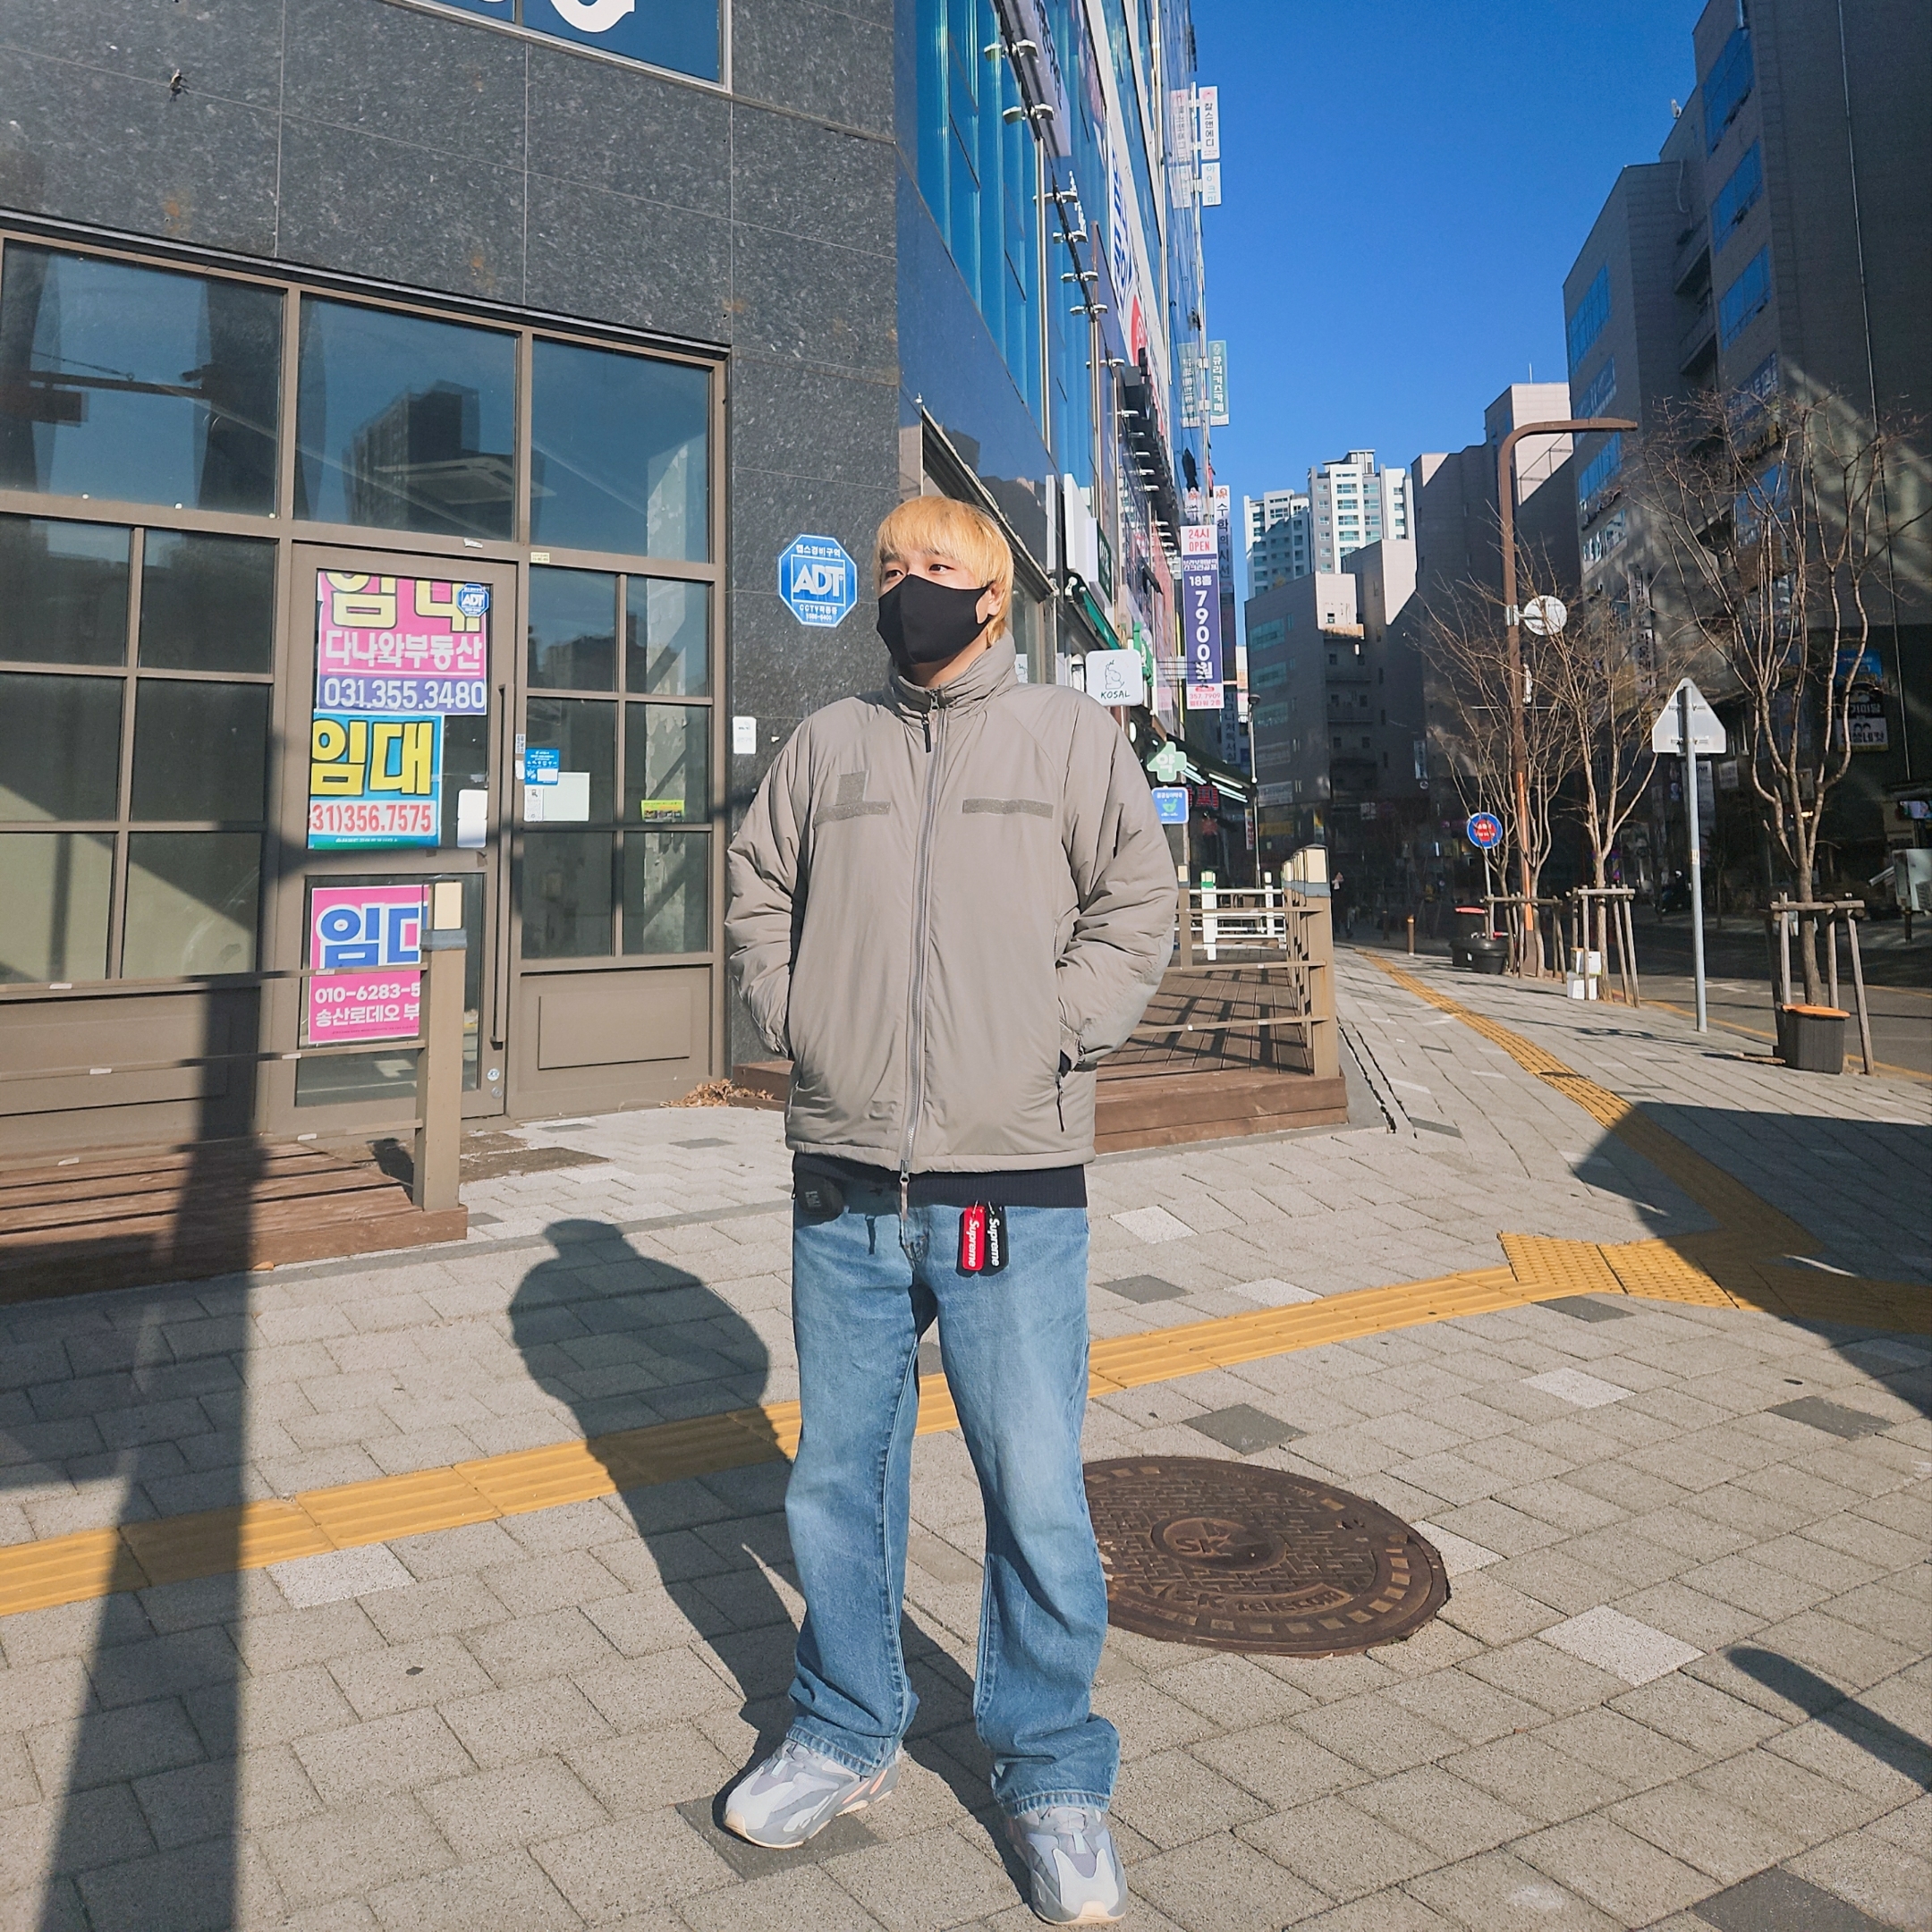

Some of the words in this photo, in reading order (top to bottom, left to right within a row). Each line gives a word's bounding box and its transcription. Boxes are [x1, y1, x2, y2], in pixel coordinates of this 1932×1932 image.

[1189, 529, 1209, 538] 24시
[1216, 503, 1231, 579] 수학의시선
[796, 544, 841, 558] 캡스경비구역
[1189, 541, 1210, 552] OPEN
[792, 564, 843, 597] ADT
[1189, 575, 1212, 587] 18홀
[462, 593, 484, 606] ADT
[326, 630, 483, 670] 다나와부동산
[324, 678, 486, 709] 031.355.3480
[1100, 691, 1131, 699] KOSAL
[310, 717, 435, 797] 임대
[1156, 753, 1175, 774] 약
[309, 804, 432, 833] 31)356.7575
[316, 1004, 400, 1028] 송산로데오
[966, 1217, 980, 1267] Supreme
[987, 1217, 1001, 1267] Supreme
[1175, 1534, 1232, 1555] SK
[1173, 1587, 1227, 1611] SK
[1236, 1590, 1344, 1614] telecom
